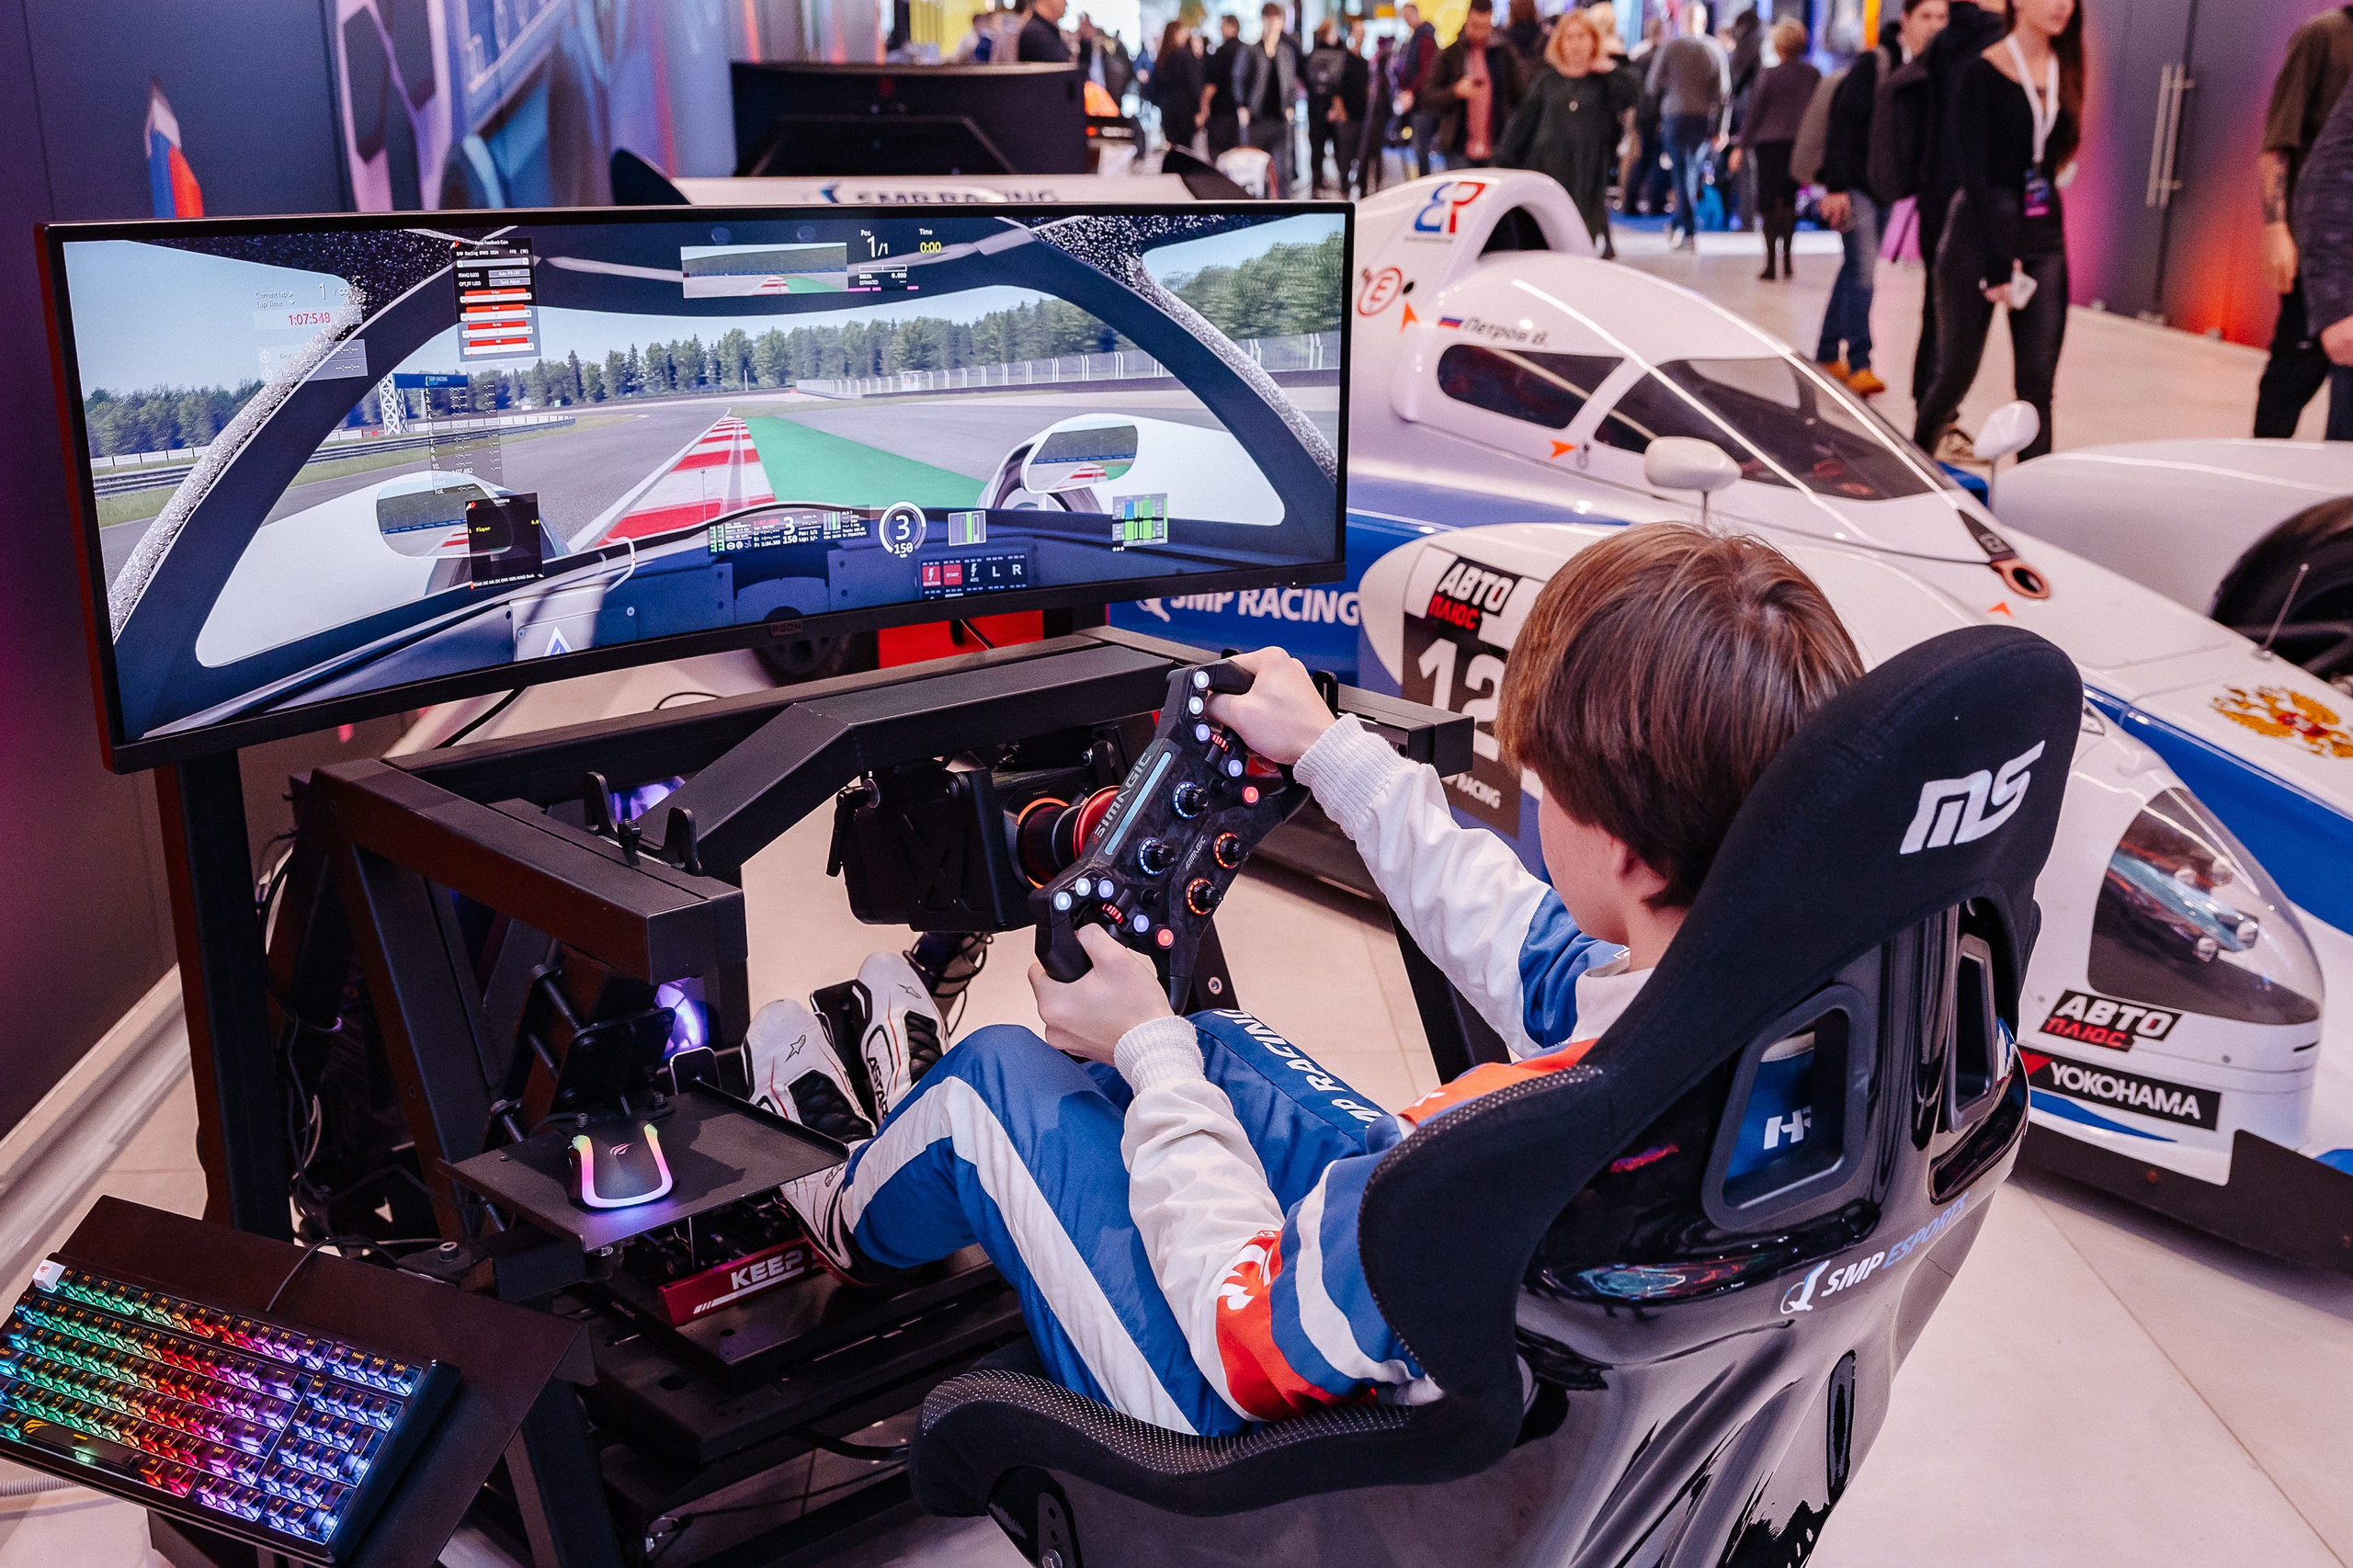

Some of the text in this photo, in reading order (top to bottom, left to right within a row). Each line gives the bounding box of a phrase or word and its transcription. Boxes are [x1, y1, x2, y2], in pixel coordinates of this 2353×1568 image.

[920, 241, 942, 254] 0:00
[782, 534, 798, 545] 150
[783, 516, 796, 536] 3
[895, 515, 911, 541] 3
[893, 541, 914, 555] 150
[992, 565, 1001, 577] L
[1012, 563, 1022, 576] R
[1437, 562, 1514, 612] АВТО
[1237, 587, 1360, 627] RACING
[1428, 594, 1479, 630] ПЛЮС
[1418, 638, 1506, 763] 12
[1094, 752, 1152, 838] SIMAGIC
[1187, 835, 1207, 869] SIMAGIC
[2044, 1017, 2129, 1048] ПЛЮС
[2055, 994, 2174, 1038] АВТО
[1211, 1009, 1347, 1092] RACING
[2051, 1061, 2201, 1120] YOKOHAMA
[1821, 1190, 1970, 1298] SMP ESPORTS
[731, 1250, 804, 1290] KEEP
[351, 1352, 365, 1360] Home
[372, 1357, 385, 1366] PgUp
